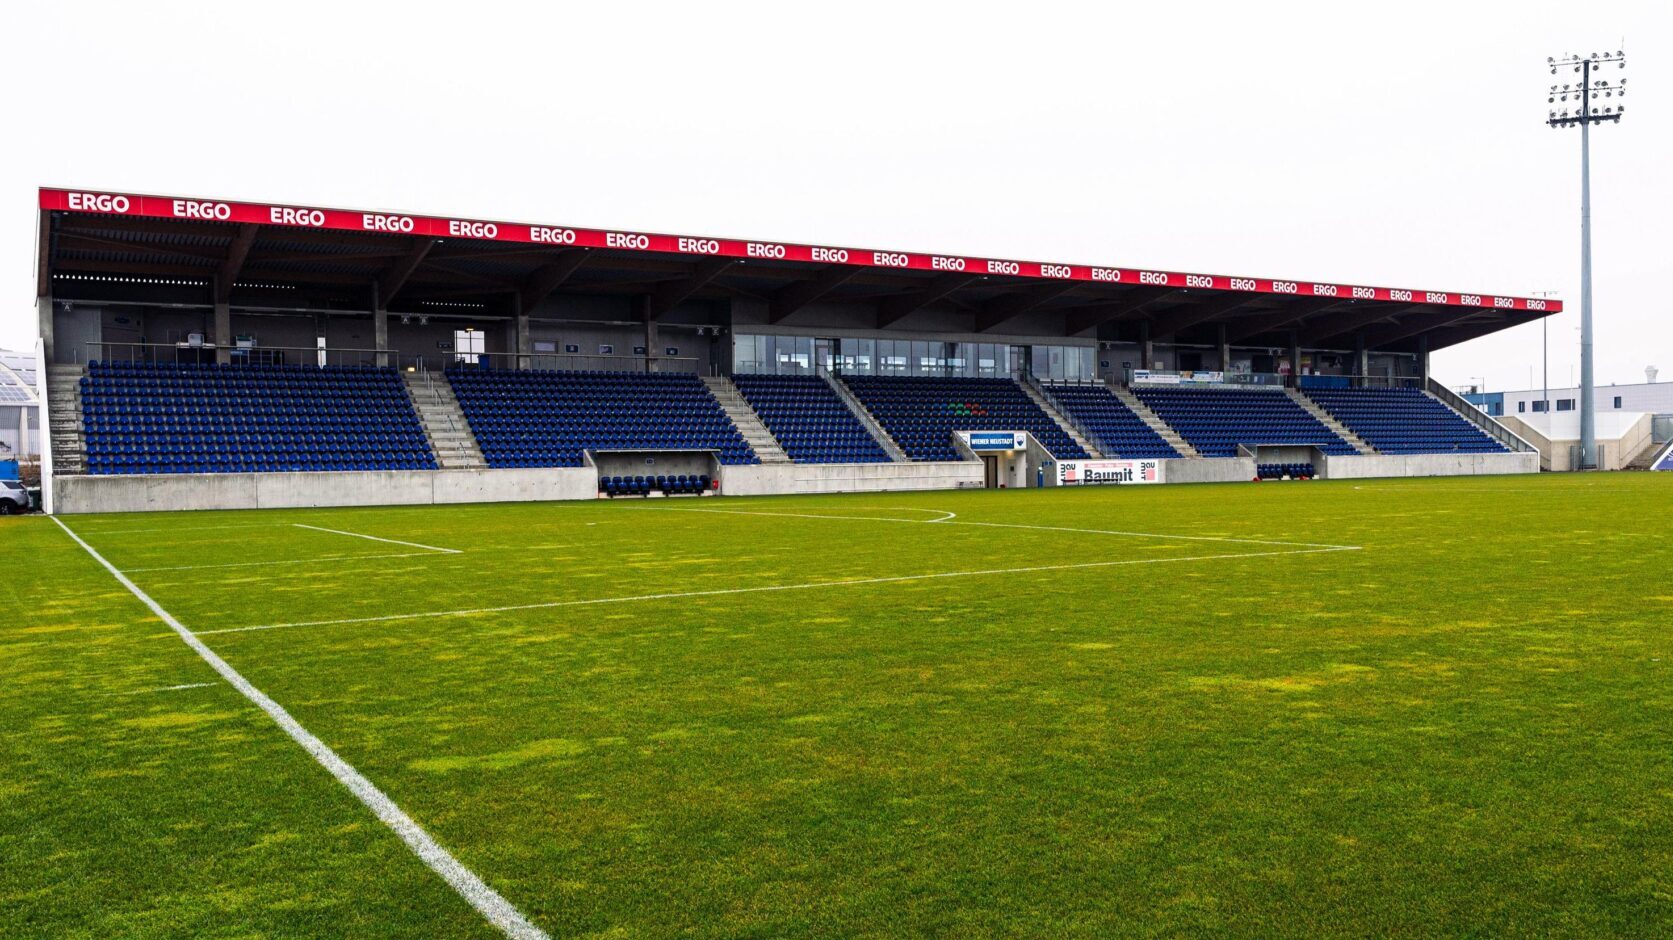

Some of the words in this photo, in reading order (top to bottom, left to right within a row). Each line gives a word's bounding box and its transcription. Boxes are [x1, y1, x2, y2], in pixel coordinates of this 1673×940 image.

[69, 193, 129, 212] ERGO
[173, 200, 230, 219] ERGO
[271, 207, 325, 225] ERGO
[363, 214, 414, 232] ERGO
[450, 221, 497, 237] ERGO
[531, 227, 575, 243] ERGO
[607, 233, 649, 248] ERGO
[679, 238, 719, 253] ERGO
[747, 243, 785, 257] ERGO
[812, 248, 848, 262] ERGO
[874, 252, 908, 266] ERGO
[932, 257, 965, 270] ERGO
[988, 261, 1019, 273] ERGO
[1041, 265, 1071, 277] ERGO
[1092, 269, 1120, 281] ERGO
[1140, 272, 1167, 285] ERGO
[1186, 276, 1213, 288] ERGO
[1231, 279, 1256, 290] ERGO
[1273, 282, 1297, 293] ERGO
[1314, 285, 1337, 296] ERGO
[1353, 288, 1375, 298] ERGO
[1390, 291, 1412, 301] ERGO
[1426, 293, 1447, 303] ERGO
[1461, 296, 1481, 305] ERGO
[1494, 298, 1514, 307] ERGO
[1527, 301, 1545, 310] ERGO
[1084, 468, 1133, 482] Baumit
